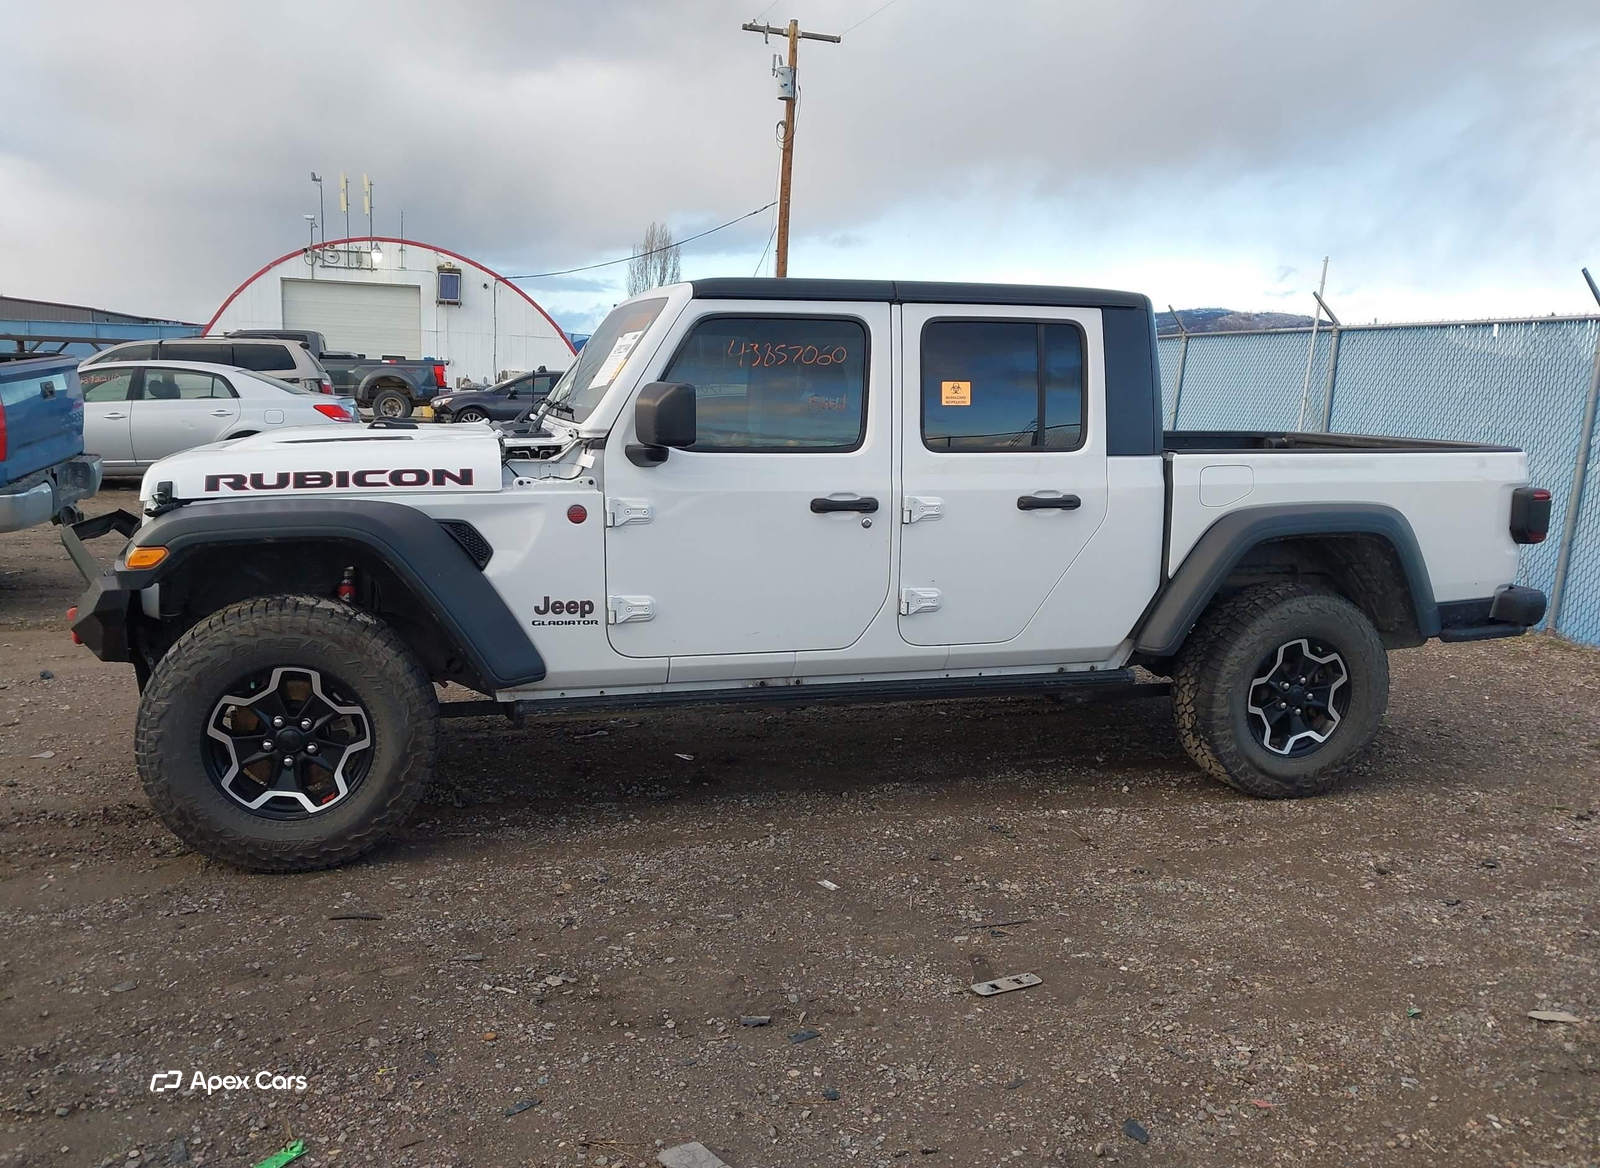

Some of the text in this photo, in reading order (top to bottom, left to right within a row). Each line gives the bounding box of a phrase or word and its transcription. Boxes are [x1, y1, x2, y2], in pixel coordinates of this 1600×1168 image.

[727, 338, 848, 367] 43857060
[204, 467, 474, 493] RUBICON
[533, 595, 595, 619] Jeep
